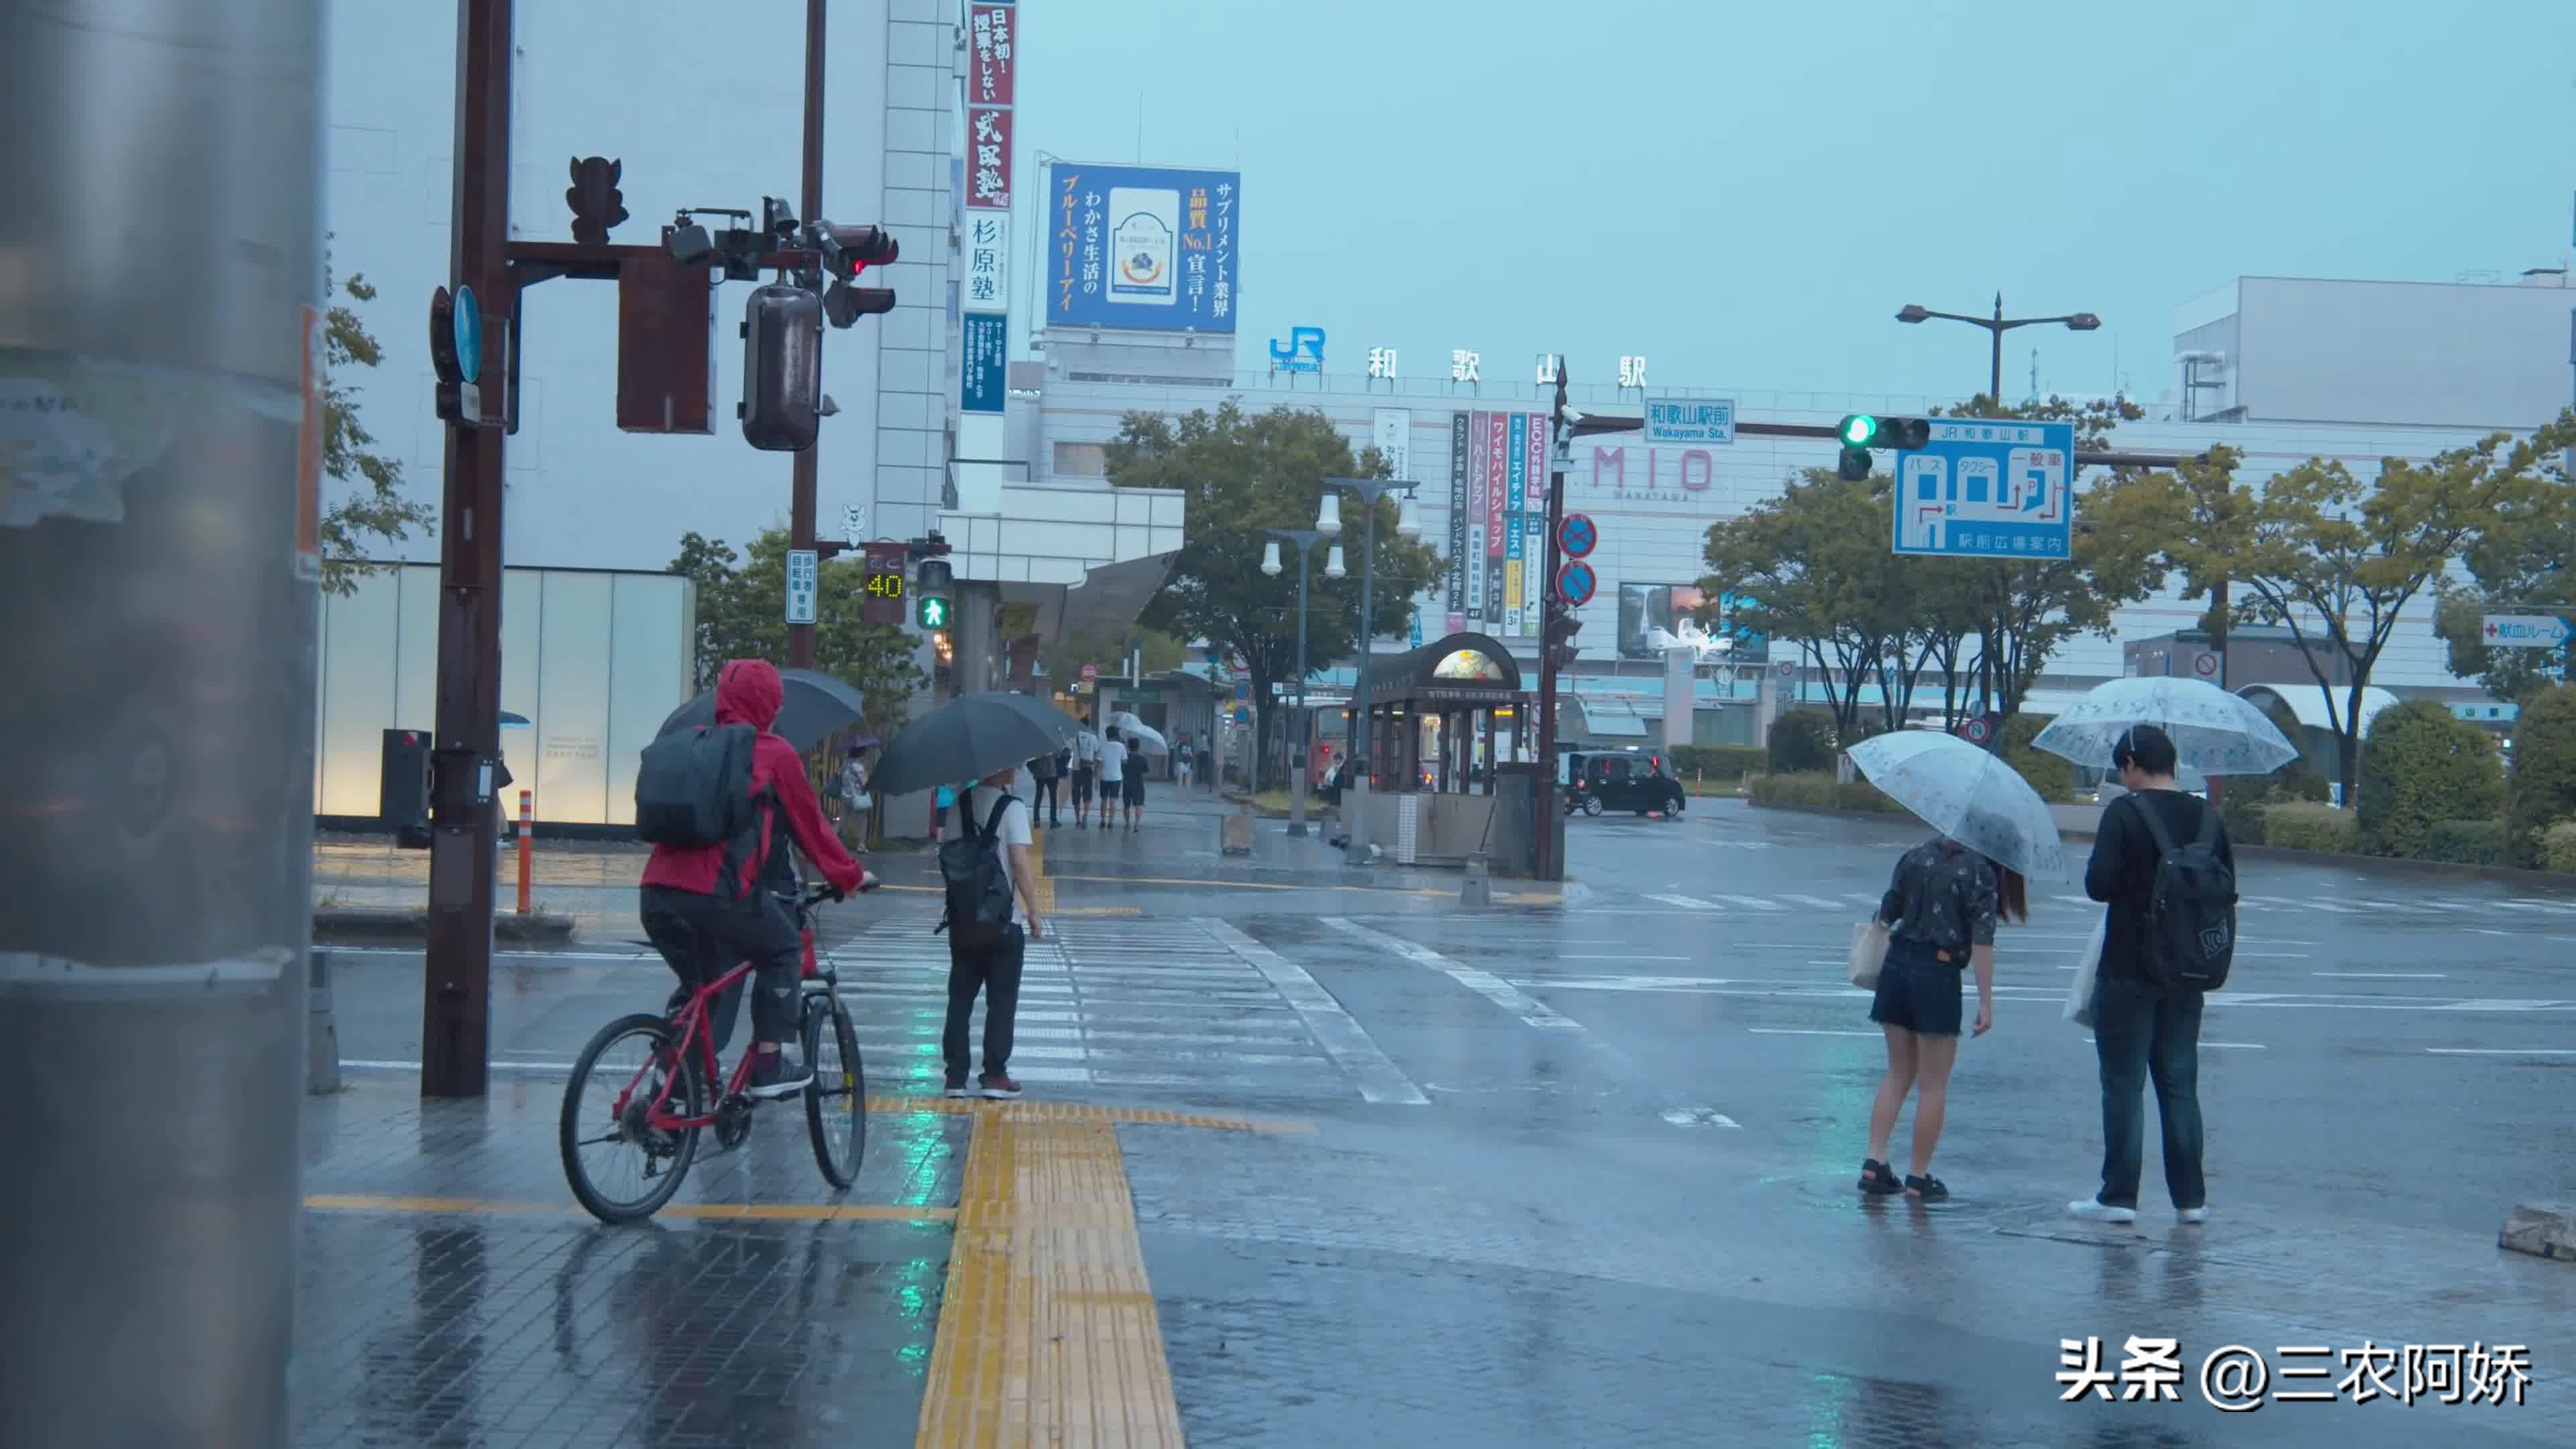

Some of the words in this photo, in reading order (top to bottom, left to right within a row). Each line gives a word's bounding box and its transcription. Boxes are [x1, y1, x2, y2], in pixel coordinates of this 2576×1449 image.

[974, 13, 996, 101] 授業をしない
[992, 9, 1010, 74] 日本初！
[975, 111, 1004, 199] 武田塾
[1059, 174, 1079, 311] ブルーベリーアイ
[1083, 191, 1101, 294] わかさ生活の
[1213, 183, 1233, 318] サプリメント業界
[971, 219, 996, 301] 杉原塾
[1270, 327, 1326, 360] JR
[1368, 346, 1646, 387] 和歌山駅
[1650, 404, 1729, 425] 和歌山駅前
[1653, 427, 1705, 439] Wakayama
[1709, 427, 1727, 439] Sta.
[1593, 445, 1711, 491] MIO
[1910, 459, 1943, 472] バス
[1959, 461, 1997, 473] タクシー
[2012, 451, 2062, 467] 一般車
[1491, 422, 1503, 548] ワイモバイルショップ
[2028, 480, 2037, 491] P
[1958, 533, 2061, 552] 駅前広場案内
[868, 574, 902, 599] 40
[1469, 609, 1481, 617] 4F
[2500, 623, 2563, 638] 献血ルーム
